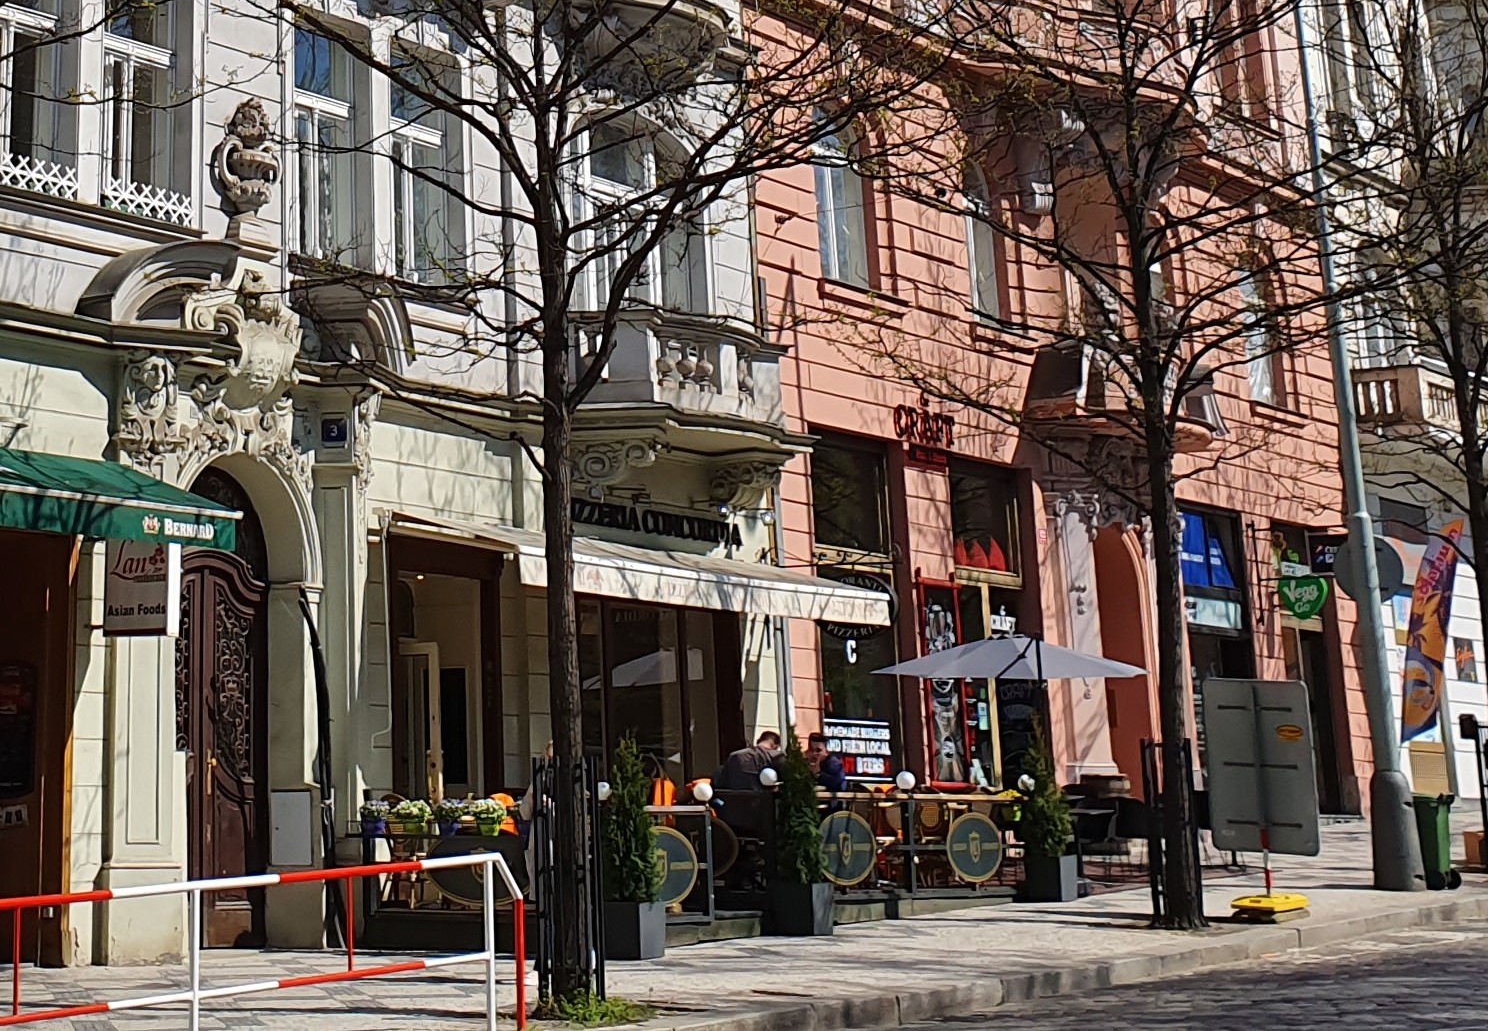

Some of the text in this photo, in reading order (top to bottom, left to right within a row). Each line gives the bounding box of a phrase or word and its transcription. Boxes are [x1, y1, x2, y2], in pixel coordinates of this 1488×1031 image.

[329, 424, 338, 437] 3
[893, 403, 954, 449] CRAFT
[164, 518, 215, 540] BERNARD
[110, 540, 147, 581] Lan
[1282, 579, 1320, 604] Vegg
[107, 603, 166, 618] Asian Foods
[1294, 601, 1312, 614] Go
[866, 740, 891, 756] LOCAL
